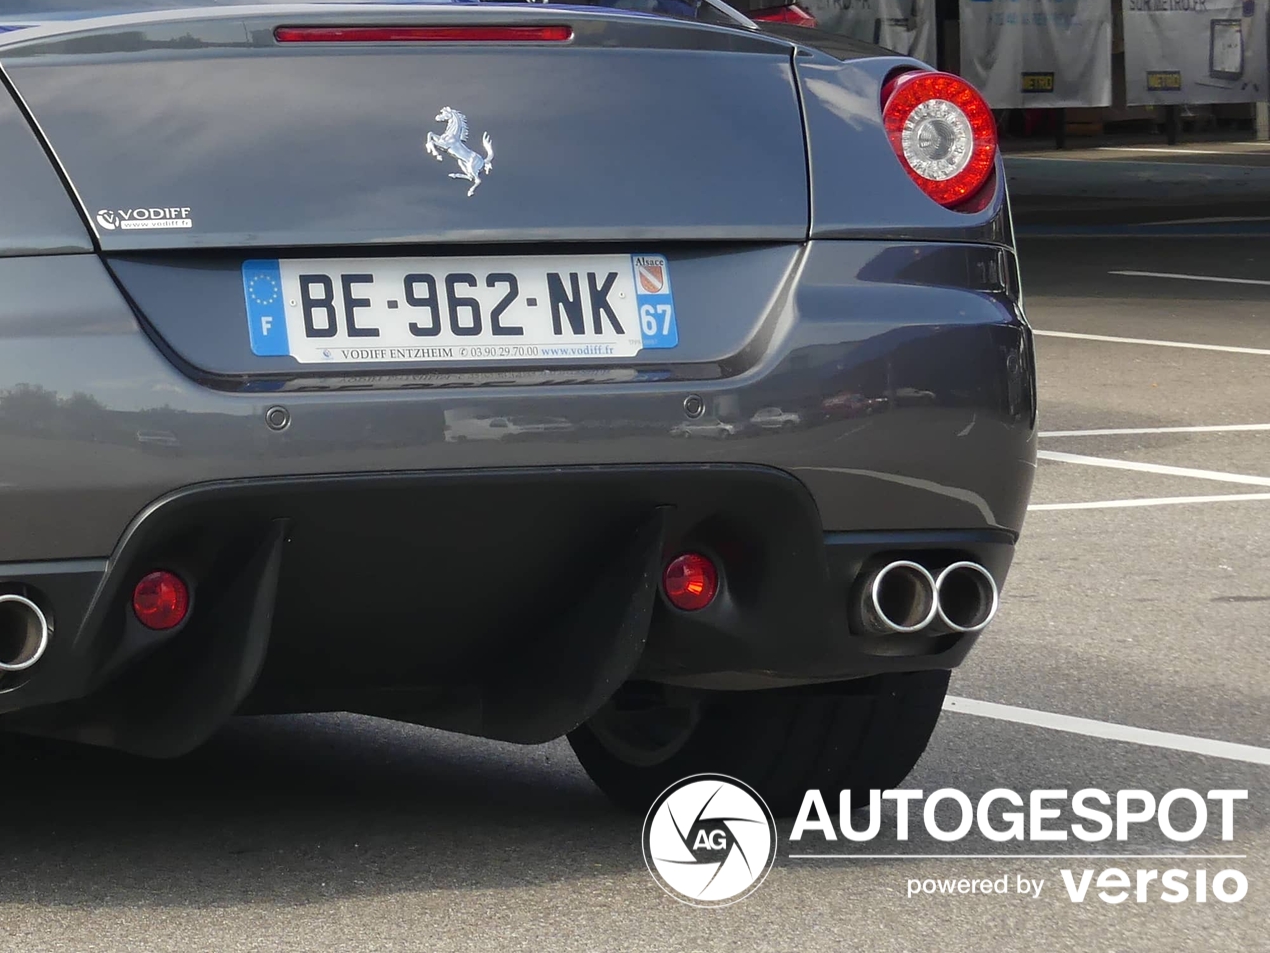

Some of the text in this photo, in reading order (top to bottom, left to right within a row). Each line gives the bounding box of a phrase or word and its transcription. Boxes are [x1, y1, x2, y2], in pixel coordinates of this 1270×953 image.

[118, 207, 191, 220] VODIFF
[635, 257, 664, 267] Alsace
[298, 271, 625, 338] BE-962-NK
[261, 316, 273, 336] F
[640, 304, 672, 336] 67
[340, 345, 615, 359] VODIFF ENTZHEIM 03.90.29.70.00 www.vodiff.fr
